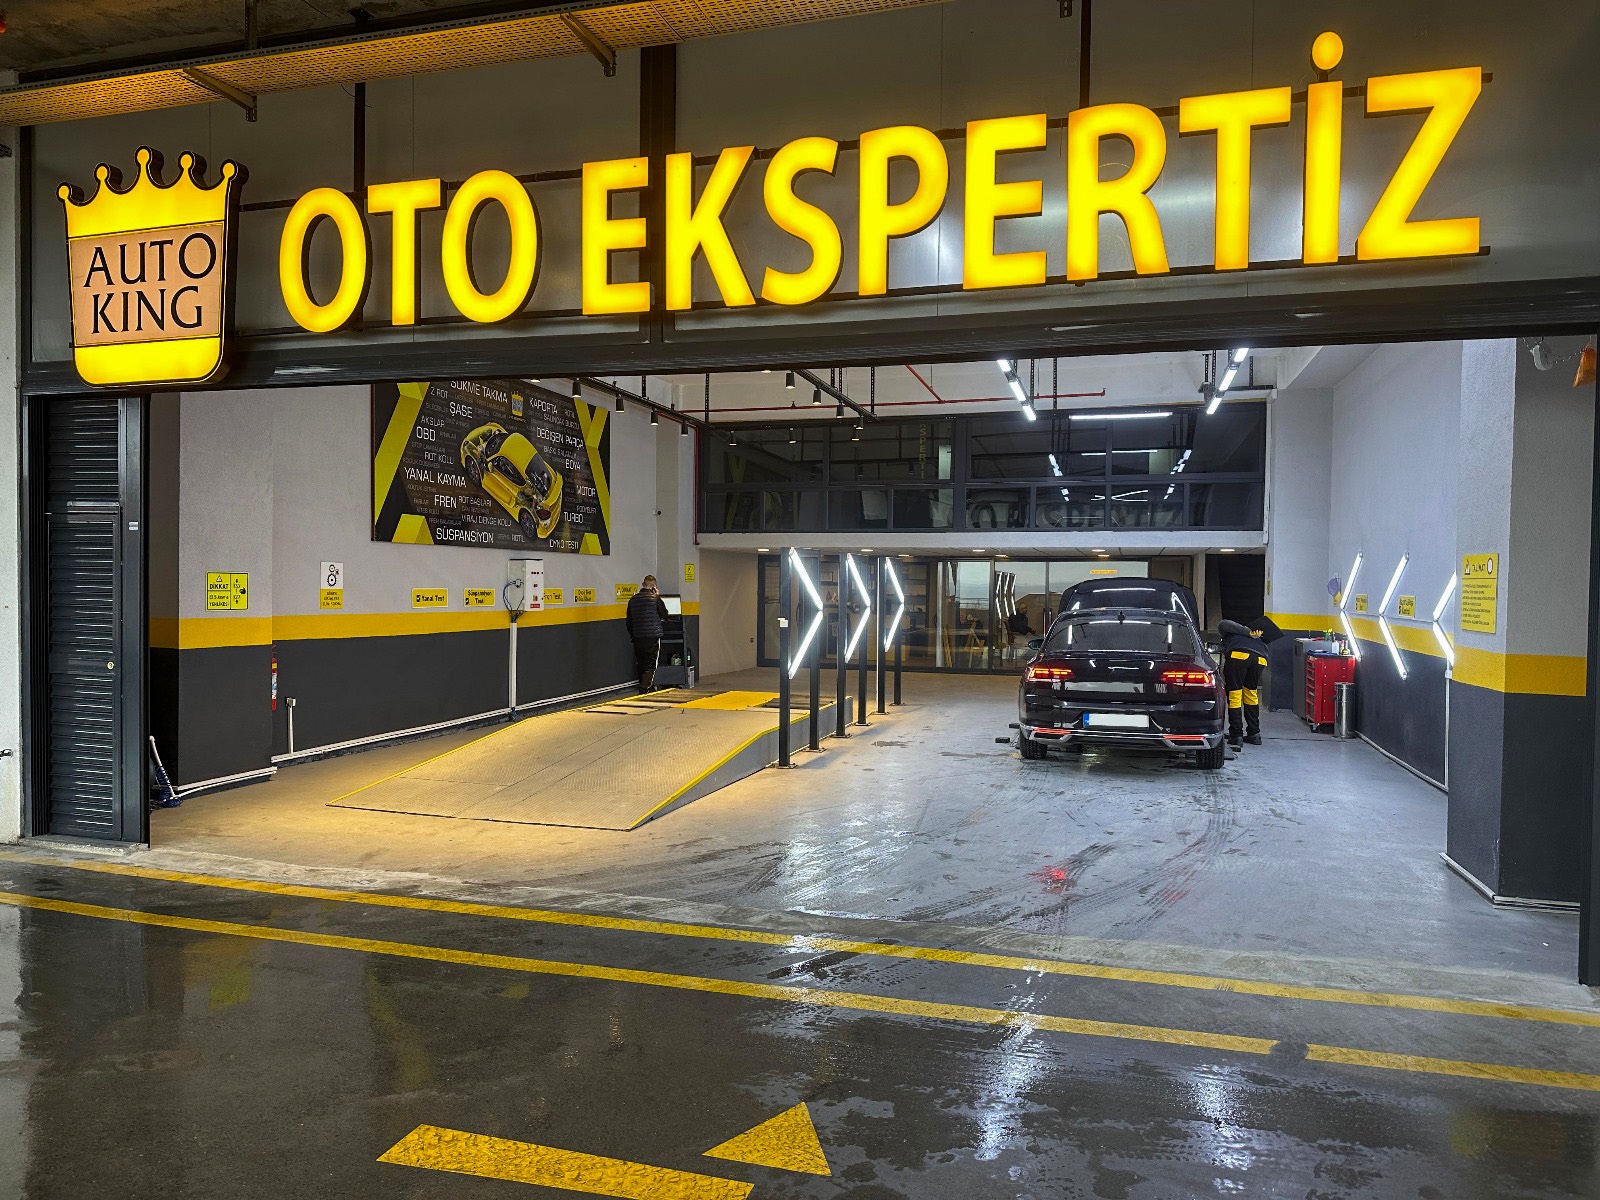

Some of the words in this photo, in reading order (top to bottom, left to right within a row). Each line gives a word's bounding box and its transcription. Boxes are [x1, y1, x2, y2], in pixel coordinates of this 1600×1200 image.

[279, 169, 538, 333] OTO
[582, 31, 1482, 314] EKSPERTİZ
[84, 232, 217, 289] AUTO
[91, 286, 204, 335] KING
[482, 386, 508, 403] TAKMA
[449, 401, 473, 419] ŞASE
[529, 398, 558, 414] KAPORTA
[416, 426, 436, 442] OBD
[404, 466, 434, 483] YANAL
[437, 472, 467, 488] KAYMA
[576, 485, 596, 498] MOTOR
[434, 494, 457, 508] FREN
[564, 511, 584, 524] TURBO
[436, 526, 494, 544] SÜSPANSİYON
[209, 582, 229, 590] DİKKAT
